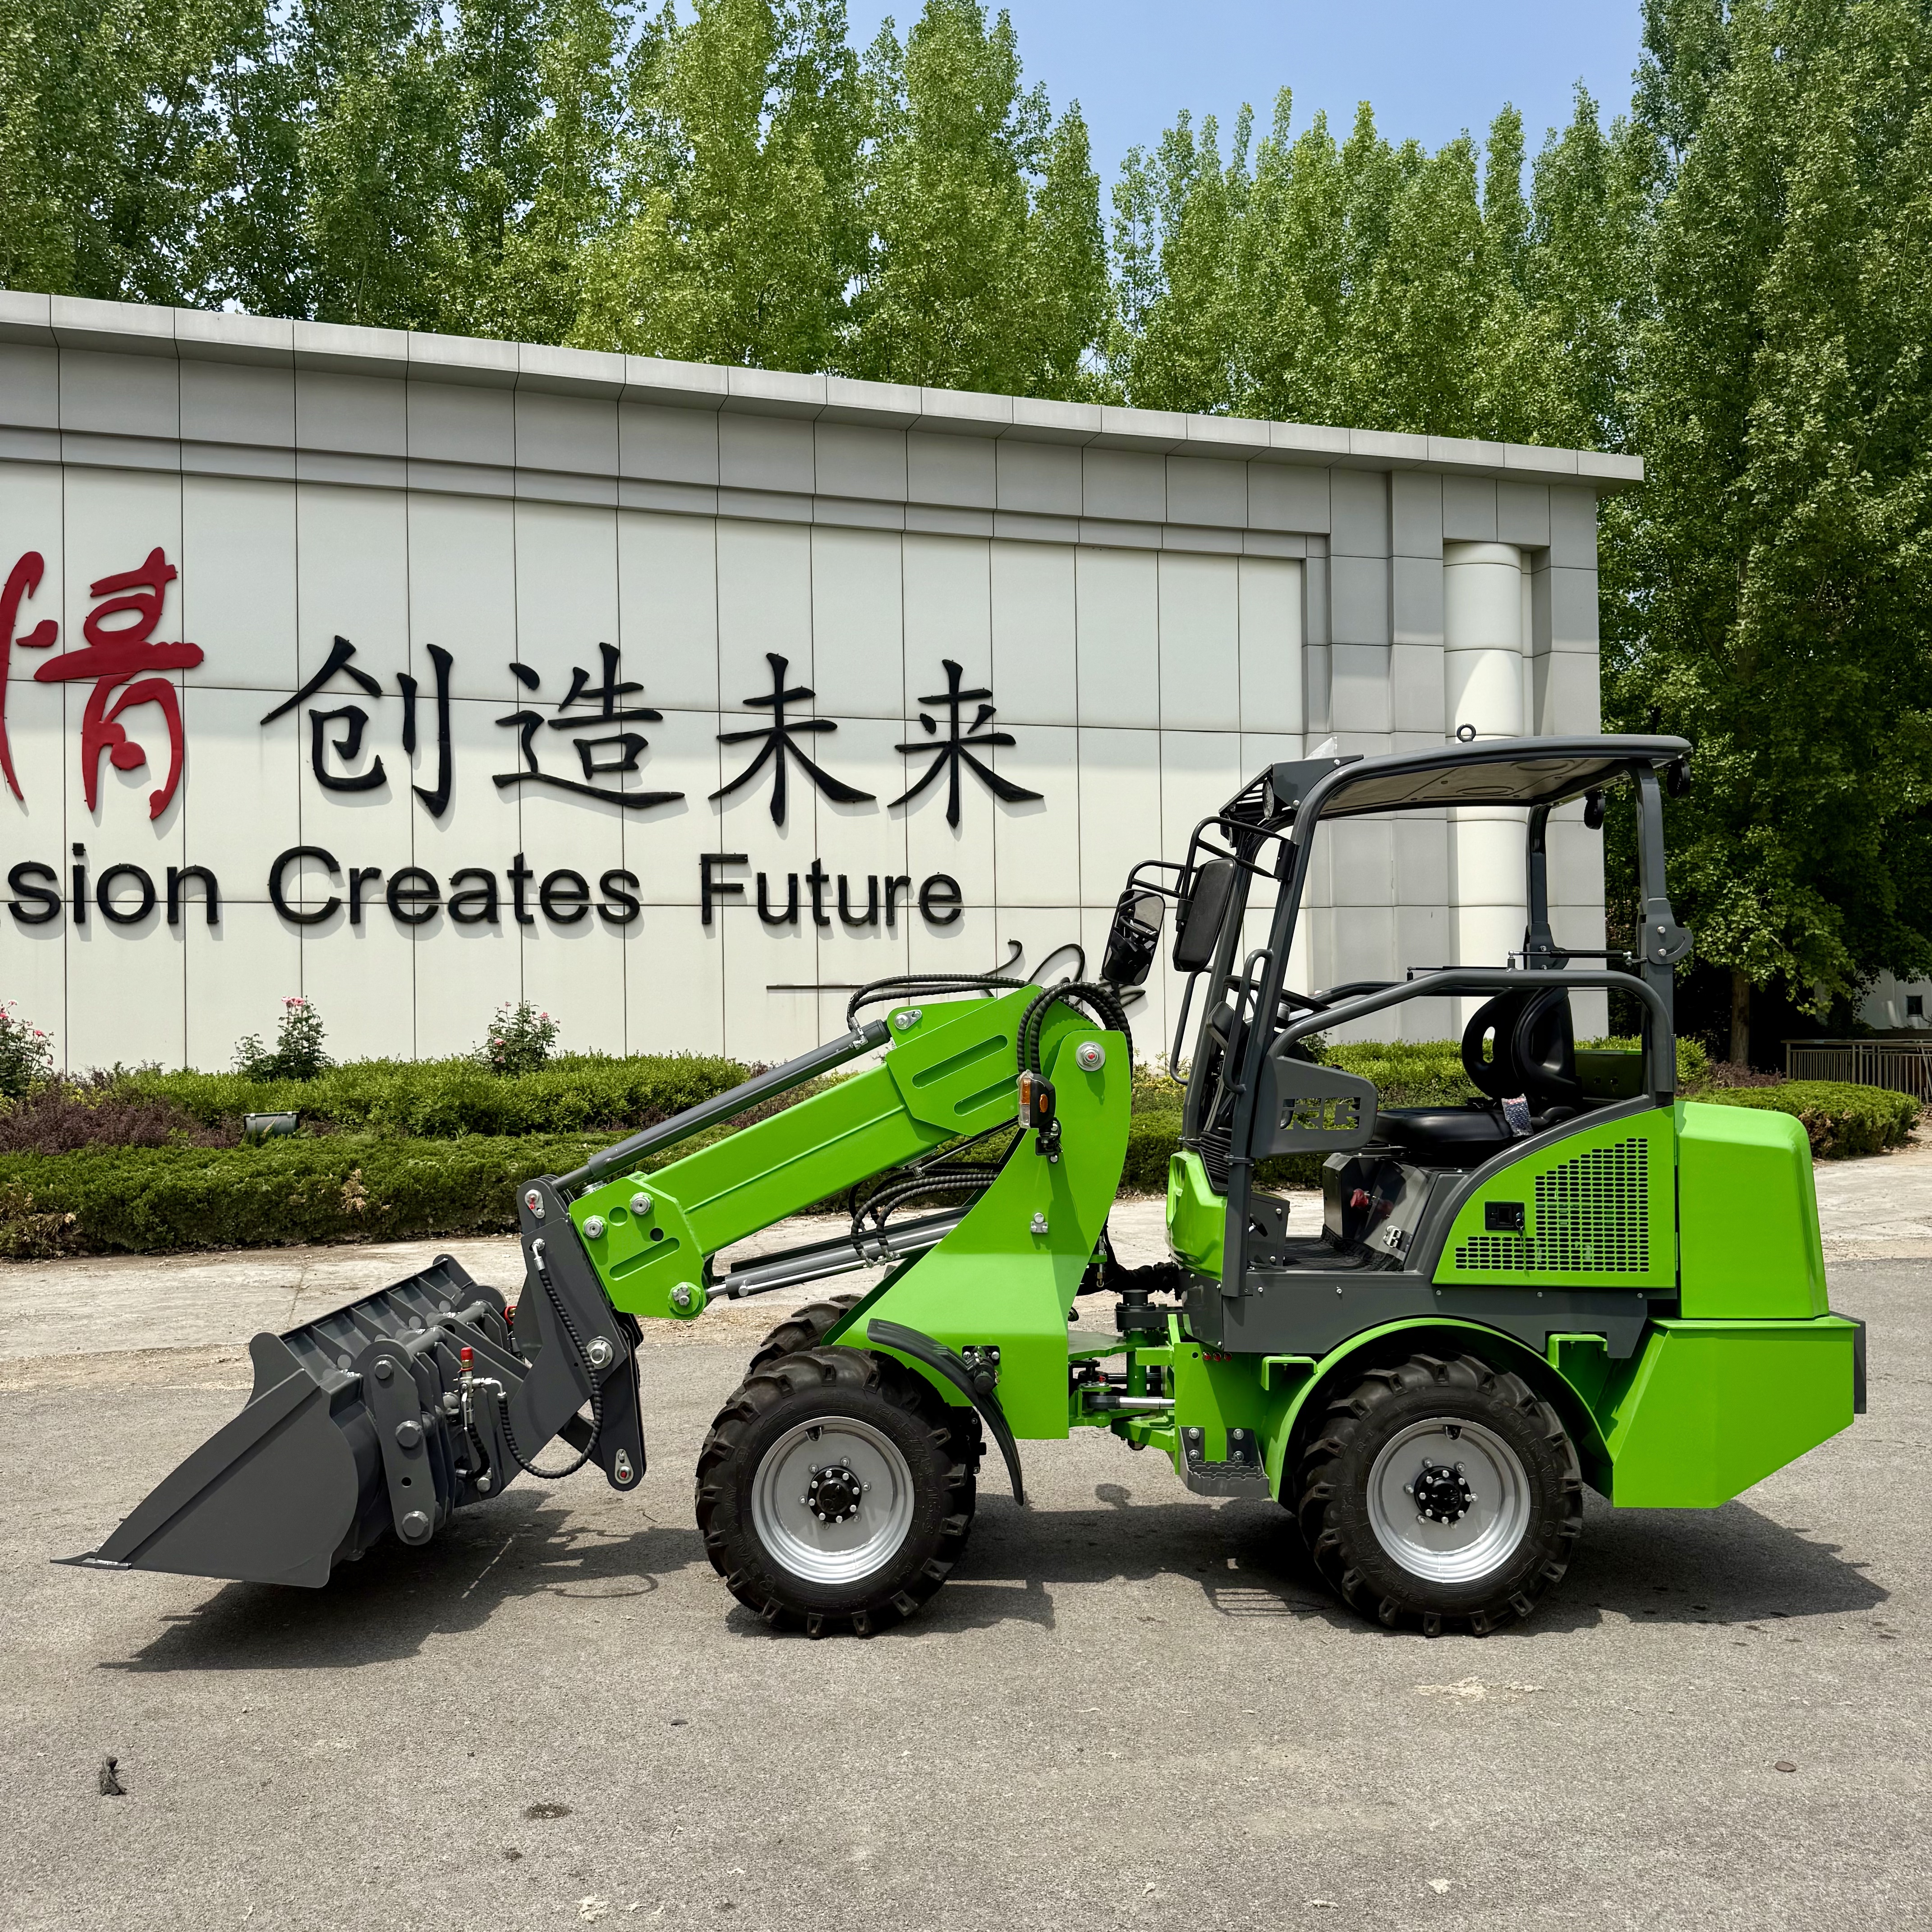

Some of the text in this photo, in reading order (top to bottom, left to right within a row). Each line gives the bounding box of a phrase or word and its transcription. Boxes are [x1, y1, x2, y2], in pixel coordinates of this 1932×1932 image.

[261, 635, 1044, 828] 创造未来
[0, 842, 962, 926] sion Creates Future
